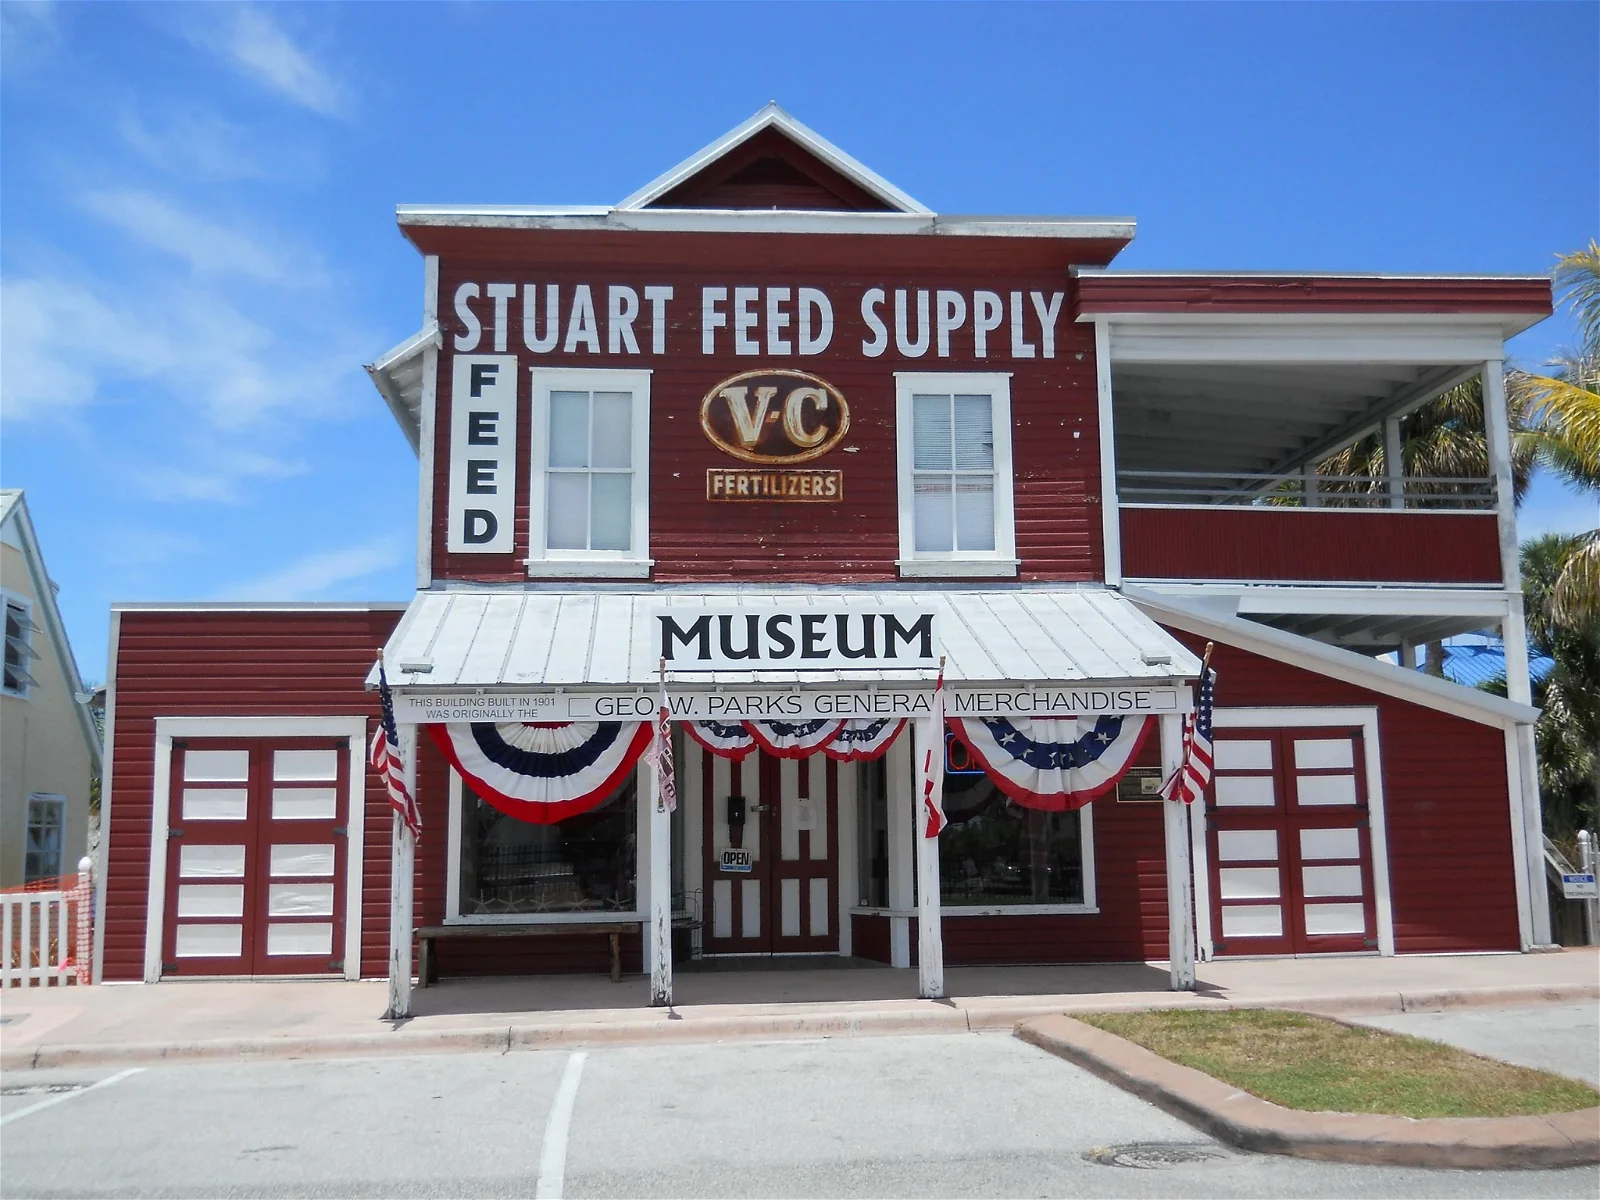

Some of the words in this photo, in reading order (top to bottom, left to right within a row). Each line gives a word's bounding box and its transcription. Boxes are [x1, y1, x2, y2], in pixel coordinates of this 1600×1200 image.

[453, 282, 674, 355] STUART
[702, 287, 834, 356] FEED
[861, 288, 1065, 359] SUPPLY
[719, 386, 830, 449] V-C
[463, 363, 500, 545] FEED
[712, 474, 838, 497] FERTILIZERS
[655, 614, 935, 660] MUSEUM
[410, 698, 433, 708] THIS
[435, 698, 485, 707] BUILDING
[488, 698, 518, 707] BUILT
[519, 698, 530, 706] IN
[533, 697, 556, 707] 1901
[426, 710, 450, 719] WAS
[452, 709, 514, 719] ORIGINALLY
[517, 709, 538, 718] THE
[595, 696, 660, 716] GEO.
[669, 696, 698, 715] W.
[708, 695, 802, 715] PARKS
[955, 691, 1152, 712] MERCHANDISE
[723, 851, 749, 865] OPEN
